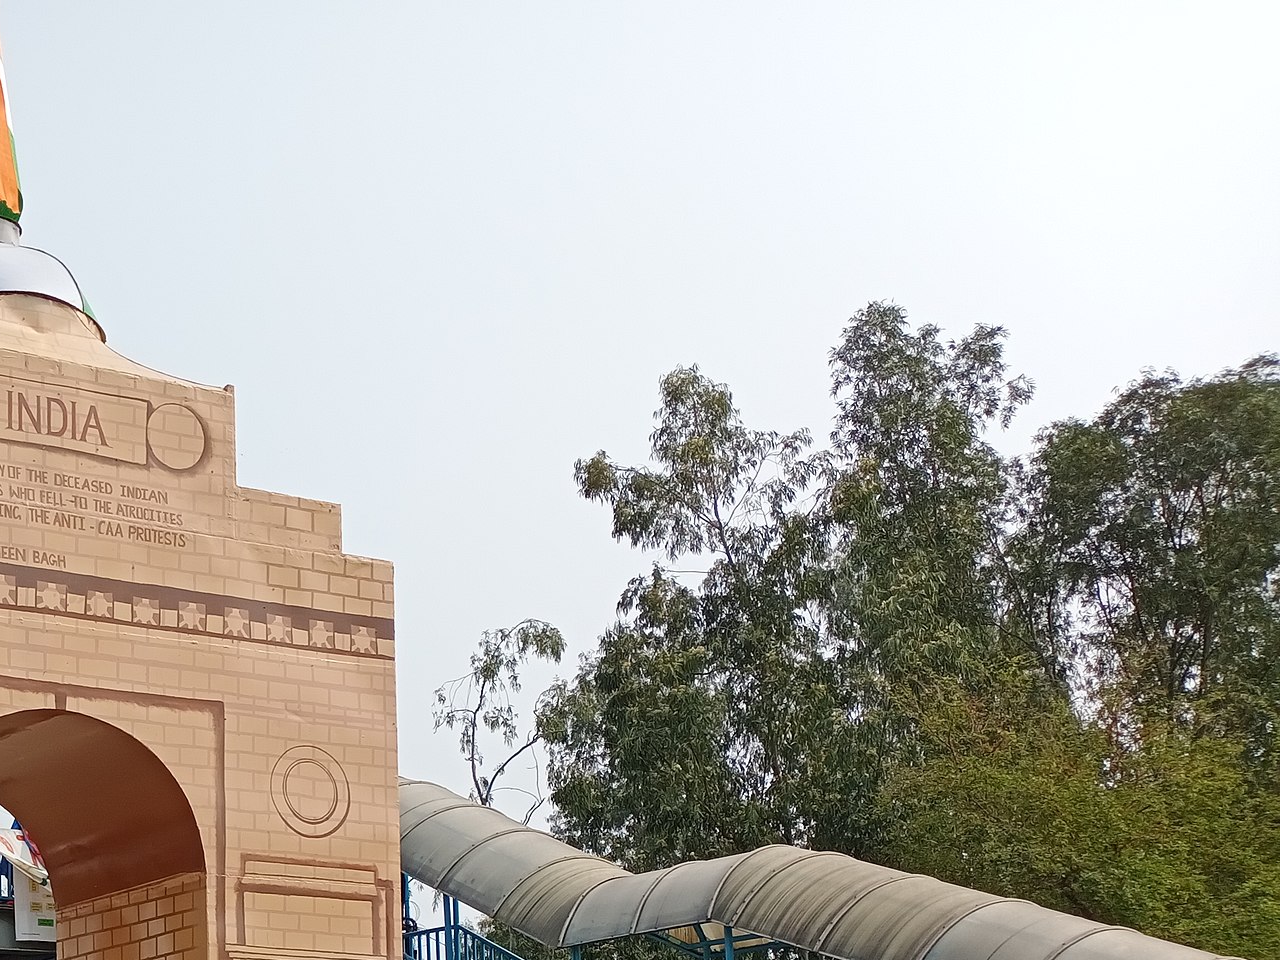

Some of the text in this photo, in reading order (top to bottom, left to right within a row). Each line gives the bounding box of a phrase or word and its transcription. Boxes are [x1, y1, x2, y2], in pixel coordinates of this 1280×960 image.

[6, 389, 111, 448] INDIA
[7, 465, 22, 480] OF
[26, 468, 48, 485] THE
[54, 473, 113, 495] DECEASED
[120, 484, 169, 505] INDIAN
[8, 485, 35, 502] WHO
[93, 498, 113, 515] THE
[116, 503, 183, 526] ATROCITIES
[28, 508, 51, 525] THE
[53, 512, 86, 531] ANTI
[97, 520, 123, 538] CAA
[128, 525, 186, 548] PROTESTS
[32, 551, 67, 568] BAGH
